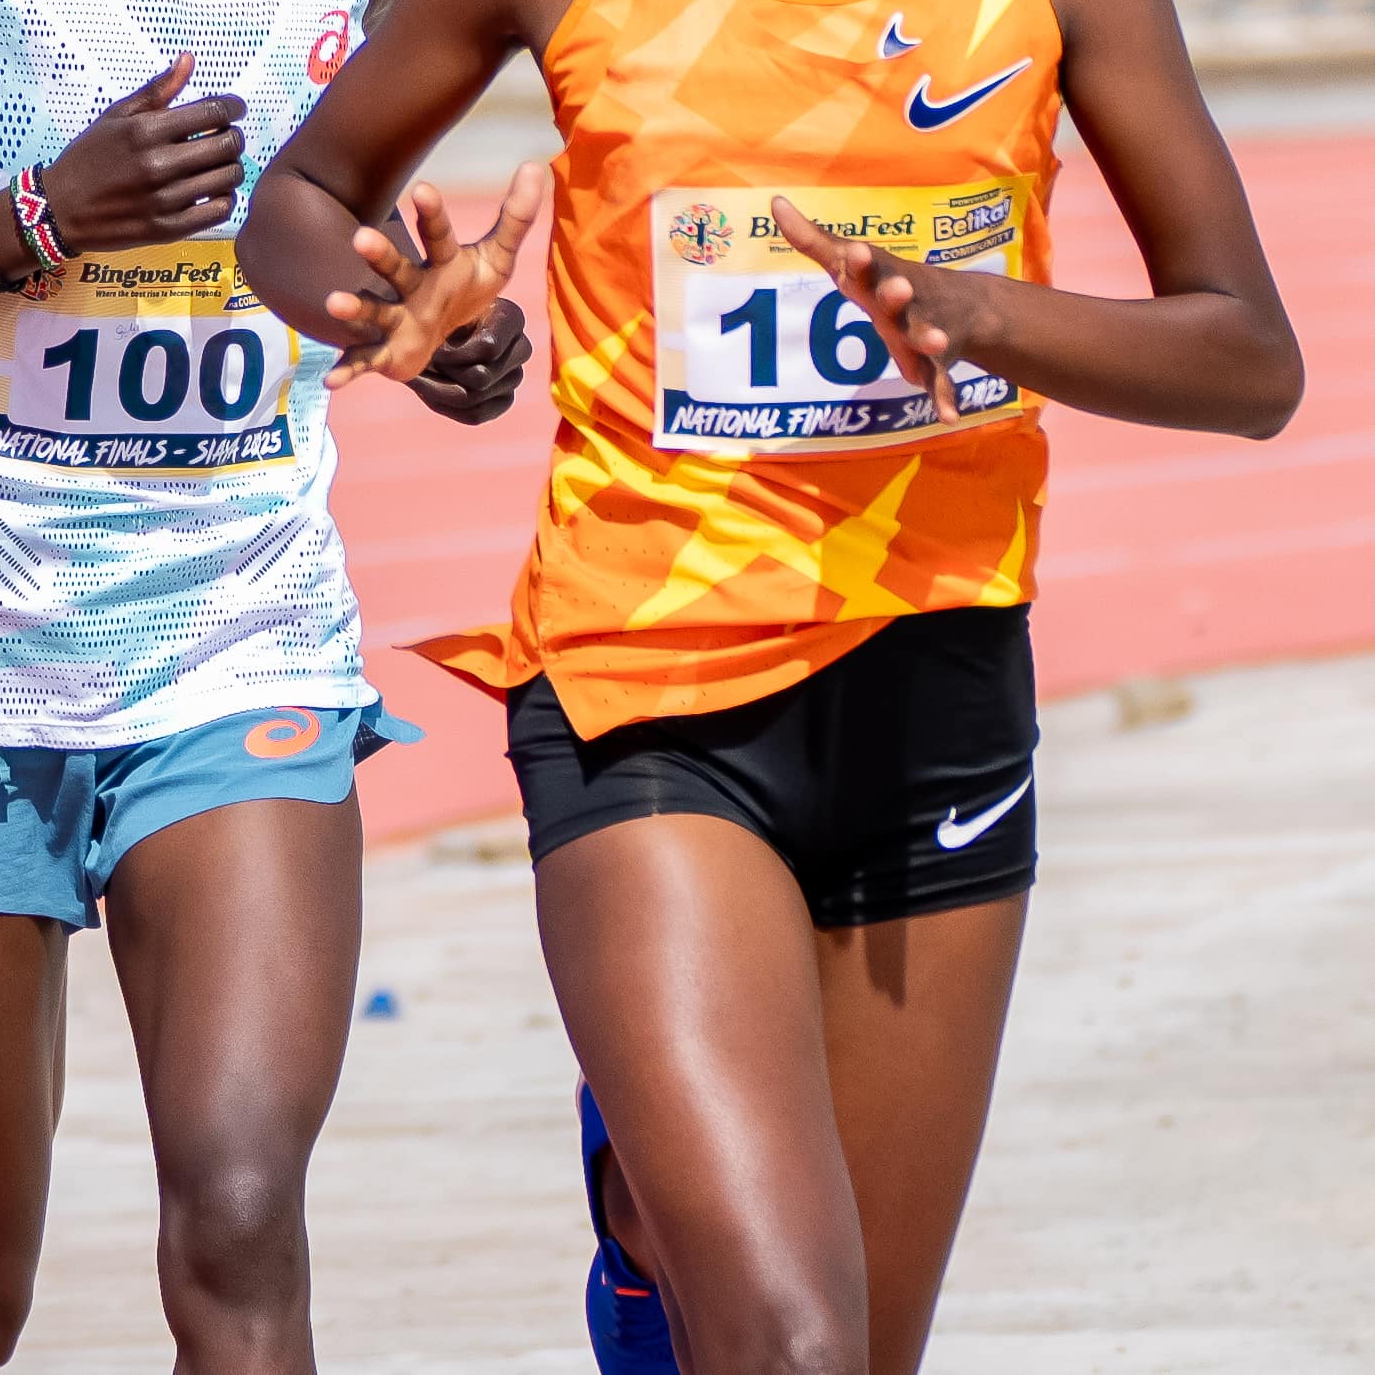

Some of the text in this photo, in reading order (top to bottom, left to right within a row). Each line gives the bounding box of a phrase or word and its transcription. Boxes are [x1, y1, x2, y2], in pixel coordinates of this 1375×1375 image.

[79, 261, 222, 288] BingwaFest
[95, 289, 116, 298] Where
[118, 289, 129, 297] the
[169, 289, 194, 297] become
[195, 289, 222, 299] legends
[720, 288, 891, 388] 16
[43, 328, 265, 422] 100
[671, 403, 784, 438] NATIONAL
[787, 403, 873, 438] FINALS
[894, 393, 939, 428] SIA
[960, 378, 1008, 410] 2025
[93, 436, 168, 467] FINALS
[188, 434, 241, 467] SIAYA
[241, 429, 282, 461] 2025
